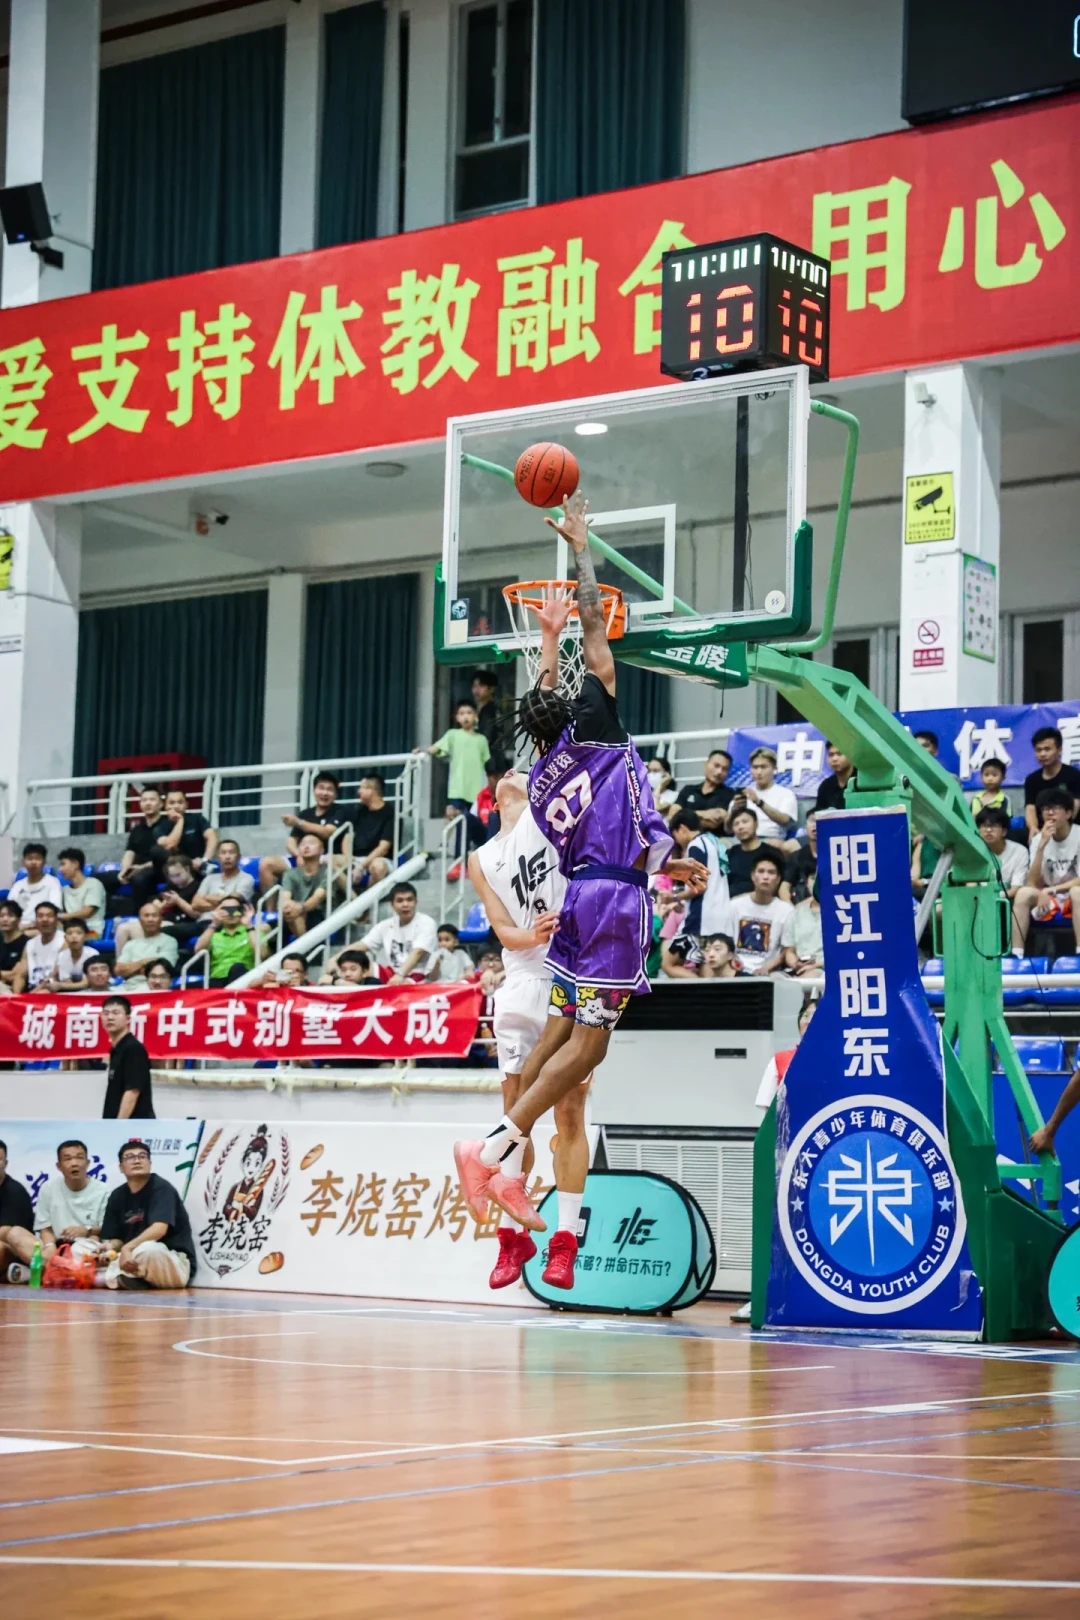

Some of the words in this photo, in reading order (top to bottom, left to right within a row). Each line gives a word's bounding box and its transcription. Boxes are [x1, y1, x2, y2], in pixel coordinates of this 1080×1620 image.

[811, 158, 1067, 312] 用心
[686, 284, 754, 361] 10
[777, 289, 823, 366] 10
[829, 833, 891, 1077] 阳江·阳东
[792, 1109, 952, 1191] 东大青少年体育俱乐部
[198, 1211, 272, 1255] 李烧窑
[795, 1227, 854, 1294] DONGDA
[859, 1271, 918, 1298] YOUTH
[918, 1224, 950, 1276] CLUB
